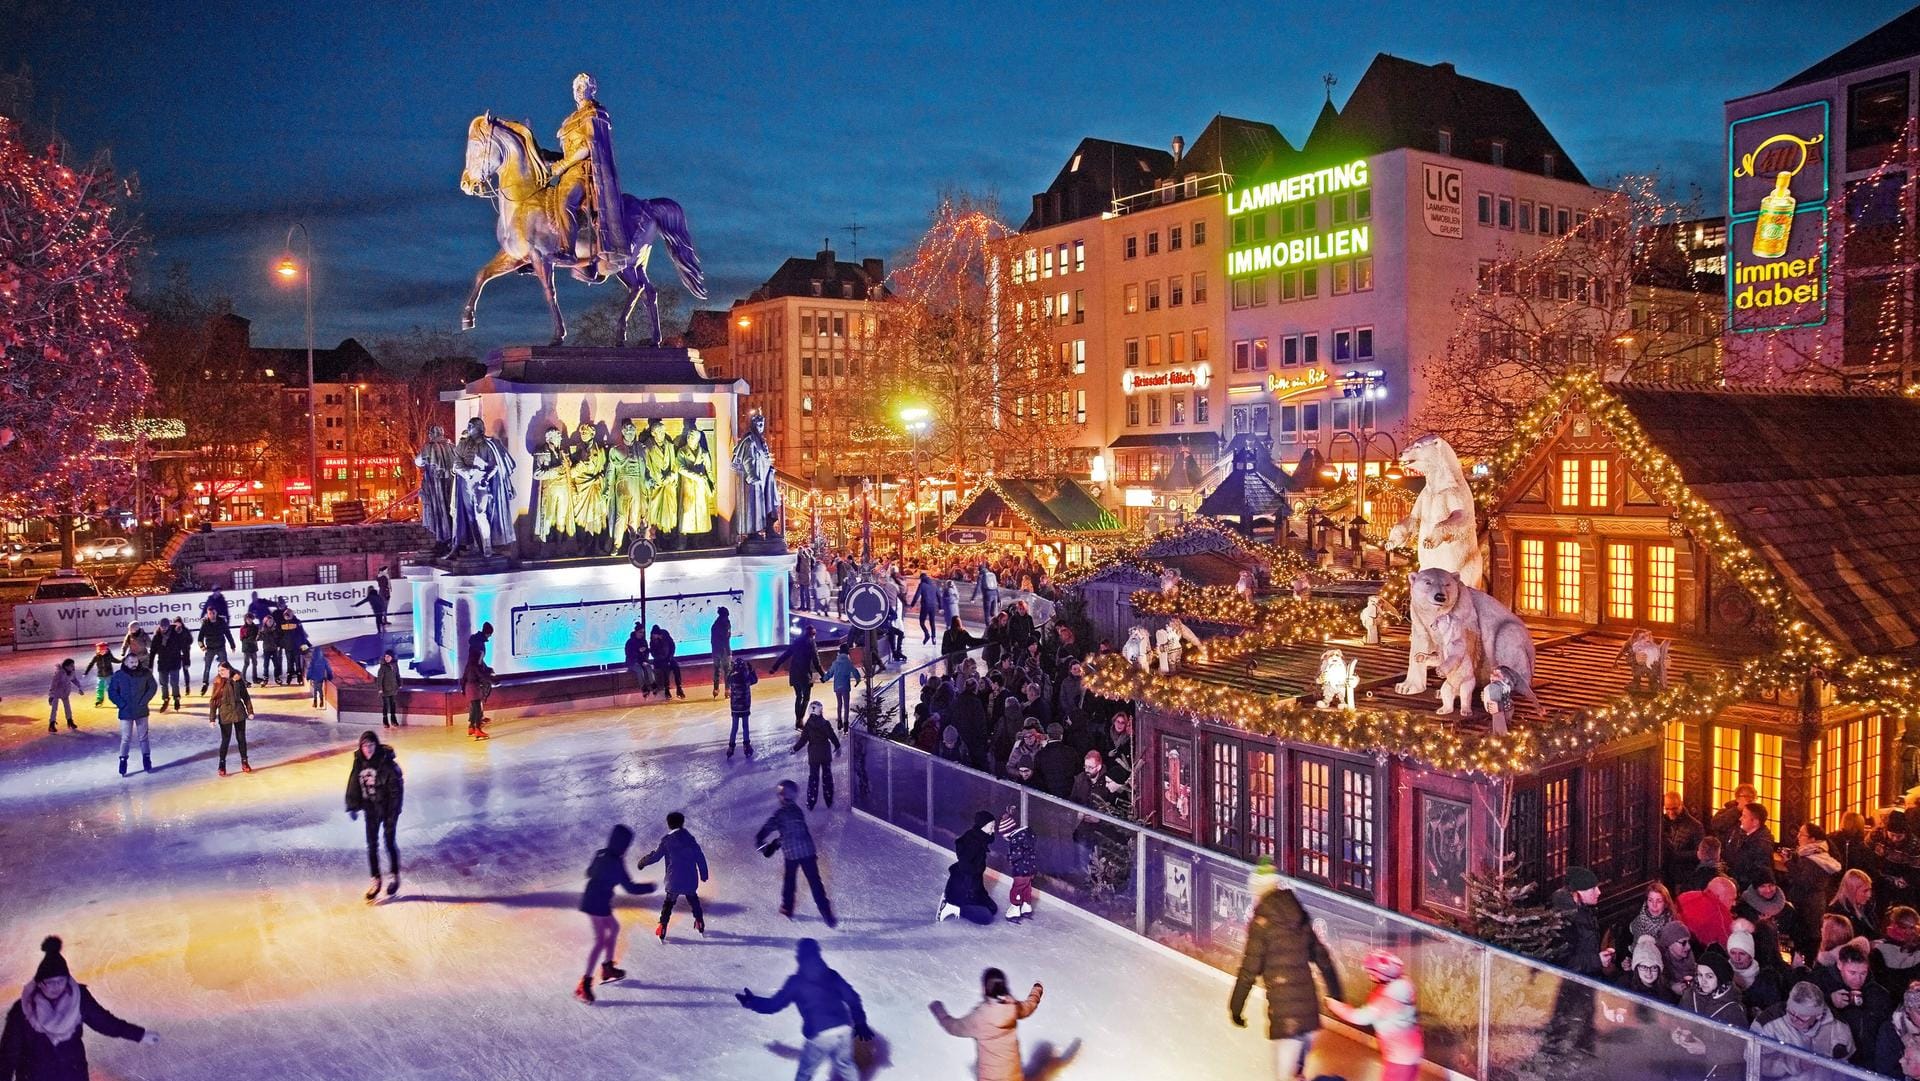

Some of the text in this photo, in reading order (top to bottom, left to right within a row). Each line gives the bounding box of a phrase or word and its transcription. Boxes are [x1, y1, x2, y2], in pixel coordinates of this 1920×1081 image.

[1227, 159, 1369, 216] LAMMERTING
[1425, 168, 1461, 204] LIG
[1228, 226, 1369, 275] IMMOBILIEN
[1735, 256, 1820, 285] immer
[1735, 278, 1819, 310] dabei
[1268, 369, 1329, 392] Bitte ein Bit
[57, 607, 90, 621] Wir
[95, 601, 192, 618] wünschen
[198, 598, 246, 612] een
[306, 587, 367, 602] Rutsch!
